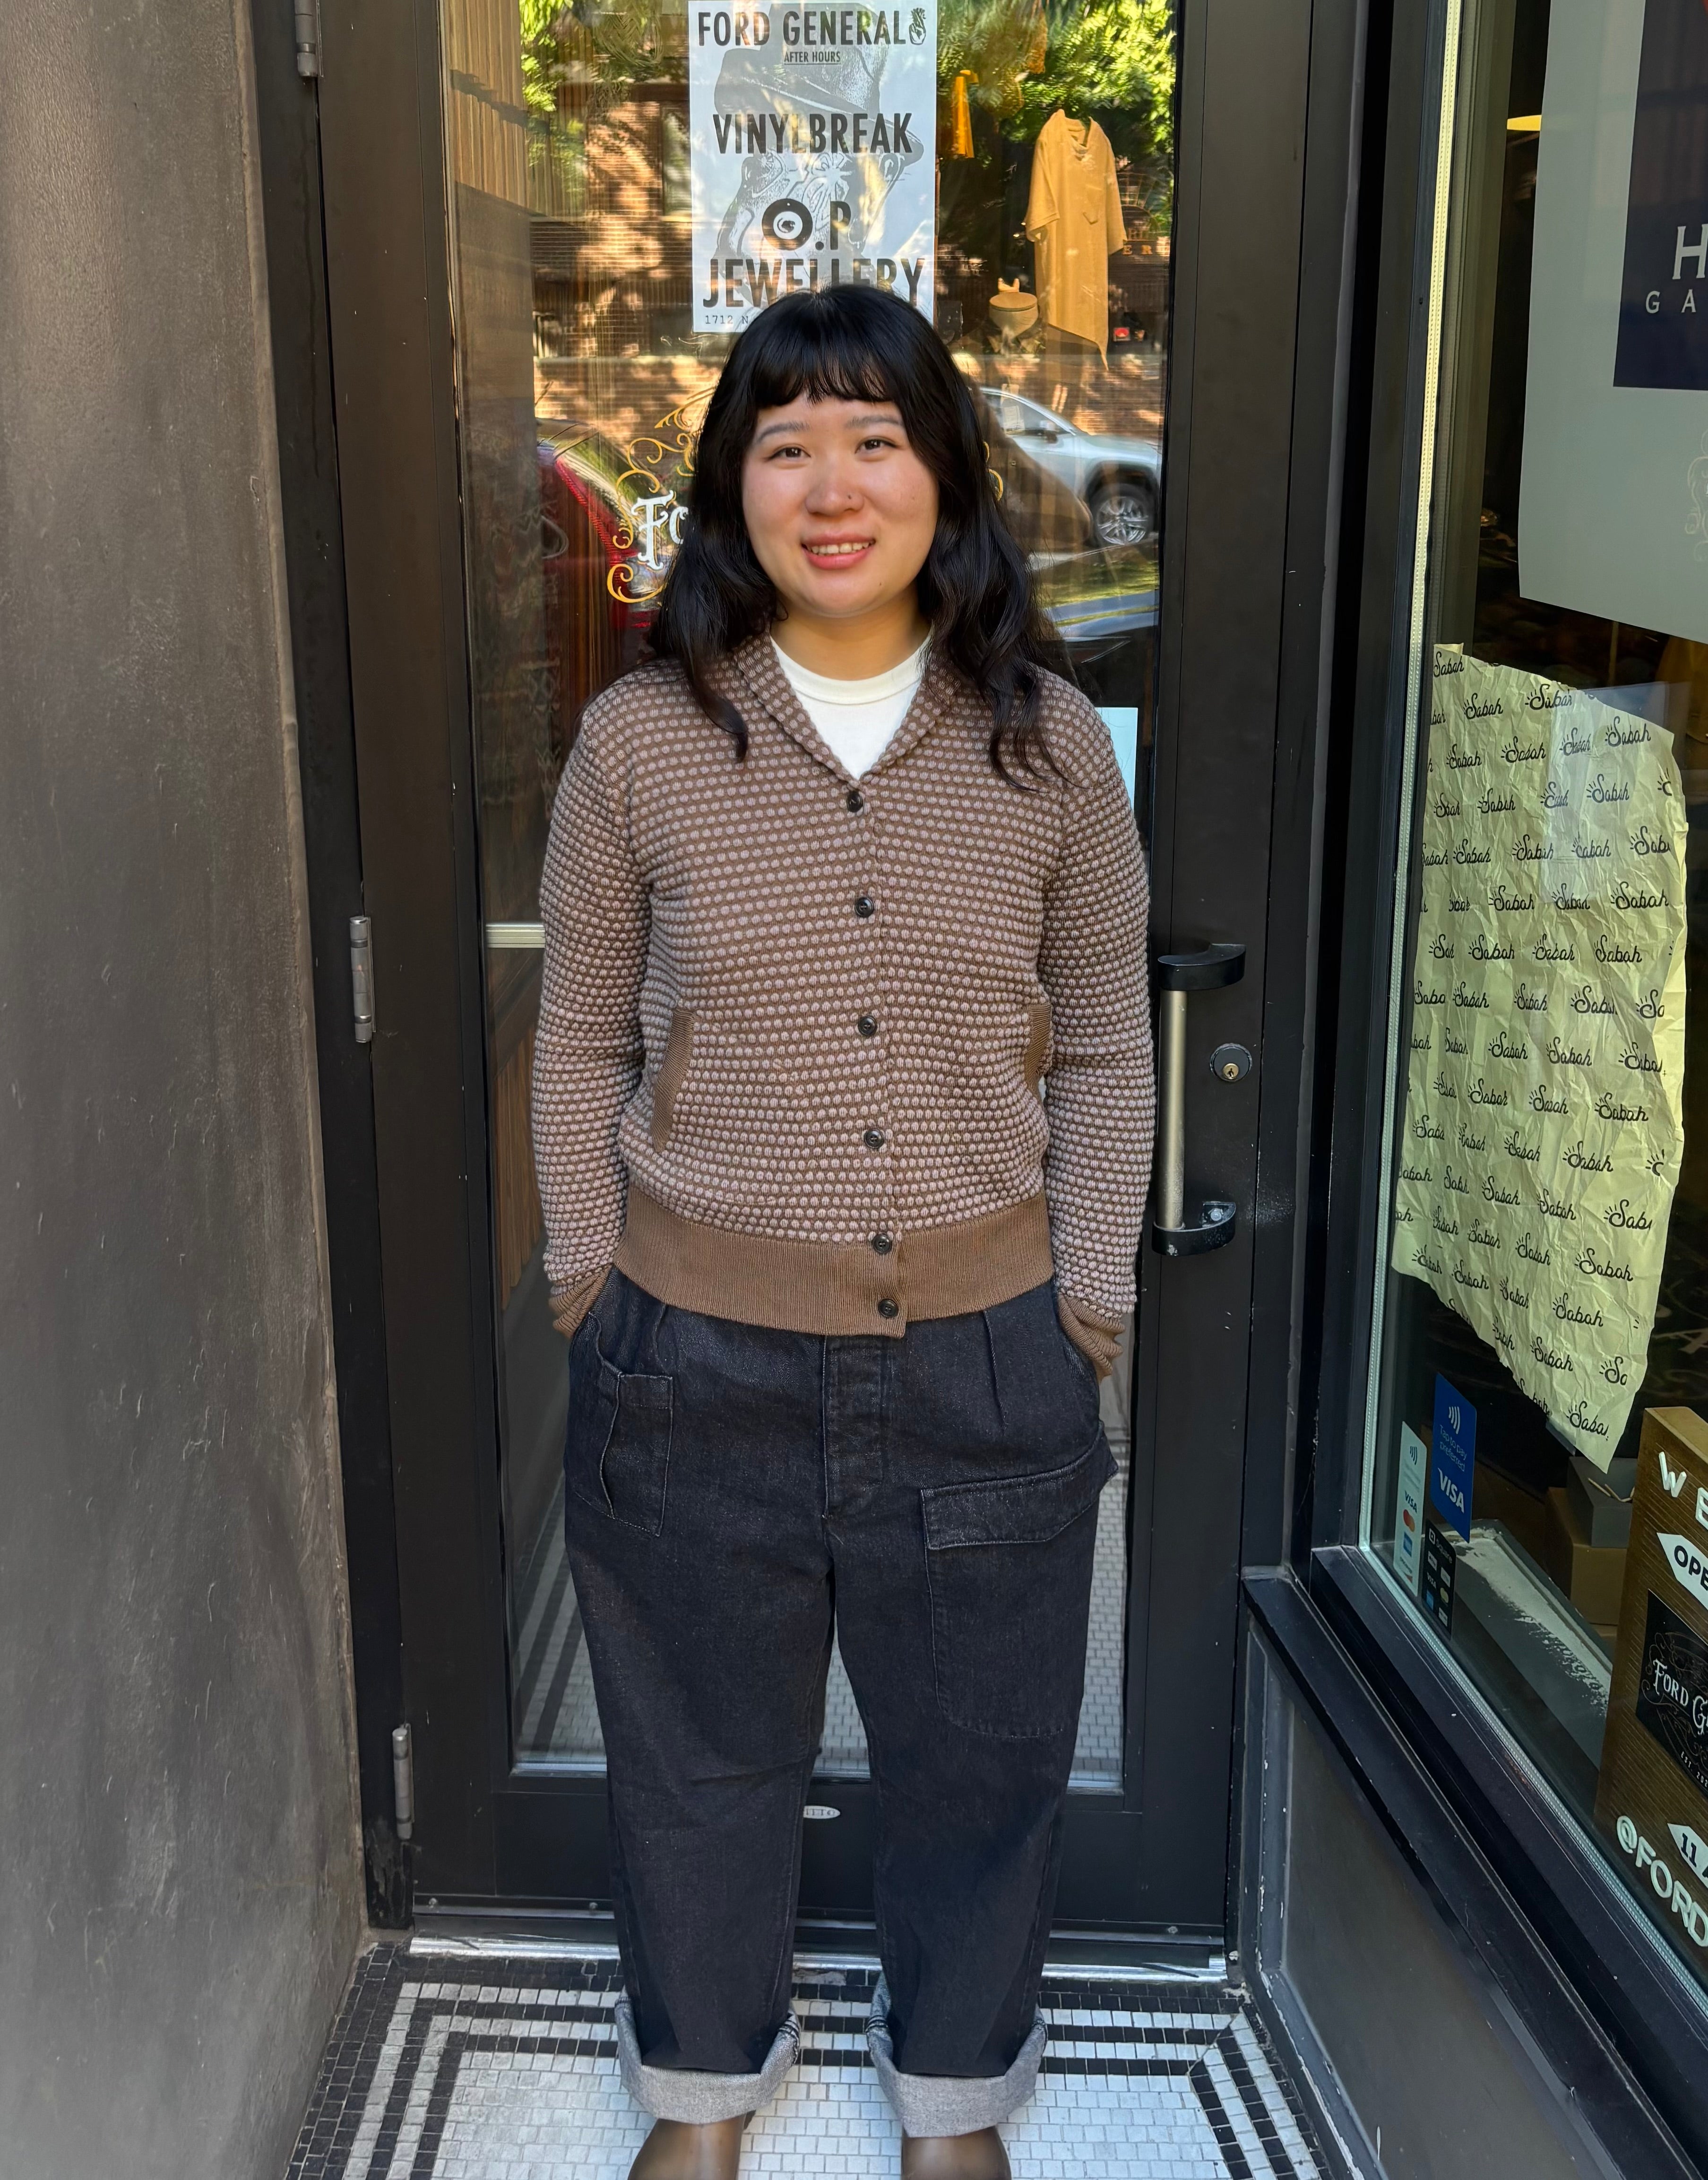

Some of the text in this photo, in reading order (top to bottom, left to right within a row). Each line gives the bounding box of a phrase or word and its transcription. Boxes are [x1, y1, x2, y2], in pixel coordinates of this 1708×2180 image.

[698, 10, 906, 46] FORD GENERAL
[784, 51, 841, 63] AFTER HOURS
[705, 315, 733, 325] 1712
[1433, 651, 1464, 677] Sabah
[1431, 709, 1446, 725] bah
[1465, 693, 1503, 719] Sabah
[1607, 716, 1651, 747] Sabah
[1449, 744, 1482, 769] Sabah
[1505, 736, 1546, 763] Sabah
[1436, 793, 1460, 818] Sbah
[1456, 838, 1491, 864] Sabah
[1517, 834, 1553, 861] Sabah
[1634, 826, 1671, 855] Sab
[1494, 885, 1535, 911] Sabah
[1615, 881, 1669, 910] Sabah
[1472, 934, 1515, 960] Sabah
[1536, 933, 1575, 960] Sabah
[1595, 935, 1642, 962] Sabah
[1415, 981, 1445, 1005] Saba
[1455, 982, 1489, 1008] Sabah
[1517, 983, 1547, 1010] Sabah
[1411, 1034, 1432, 1050] bah
[1492, 1031, 1527, 1060] Sabah
[1549, 1037, 1592, 1066] Sabah
[1470, 1078, 1508, 1105] Sabah
[1598, 1092, 1648, 1121] Sabah
[1416, 1115, 1444, 1140] Saba
[1568, 1141, 1613, 1172] Sabah
[1399, 1166, 1432, 1181] abah
[1483, 1176, 1520, 1206] Sabah
[1539, 1188, 1576, 1221] Sabah
[1609, 1199, 1653, 1230] Sab
[1468, 1219, 1501, 1249] Sabah
[1517, 1232, 1551, 1266] Sabah
[1579, 1248, 1633, 1281] Sabah
[1556, 1292, 1604, 1327] Sabah
[1440, 1424, 1449, 1441] Tap
[1457, 1444, 1467, 1460] pay
[1440, 1441, 1465, 1472] preferred
[1405, 1490, 1417, 1513] VISA
[1437, 1467, 1465, 1514] VISA
[1653, 1658, 1689, 1706] FORD
[1681, 1833, 1697, 1867] 11
